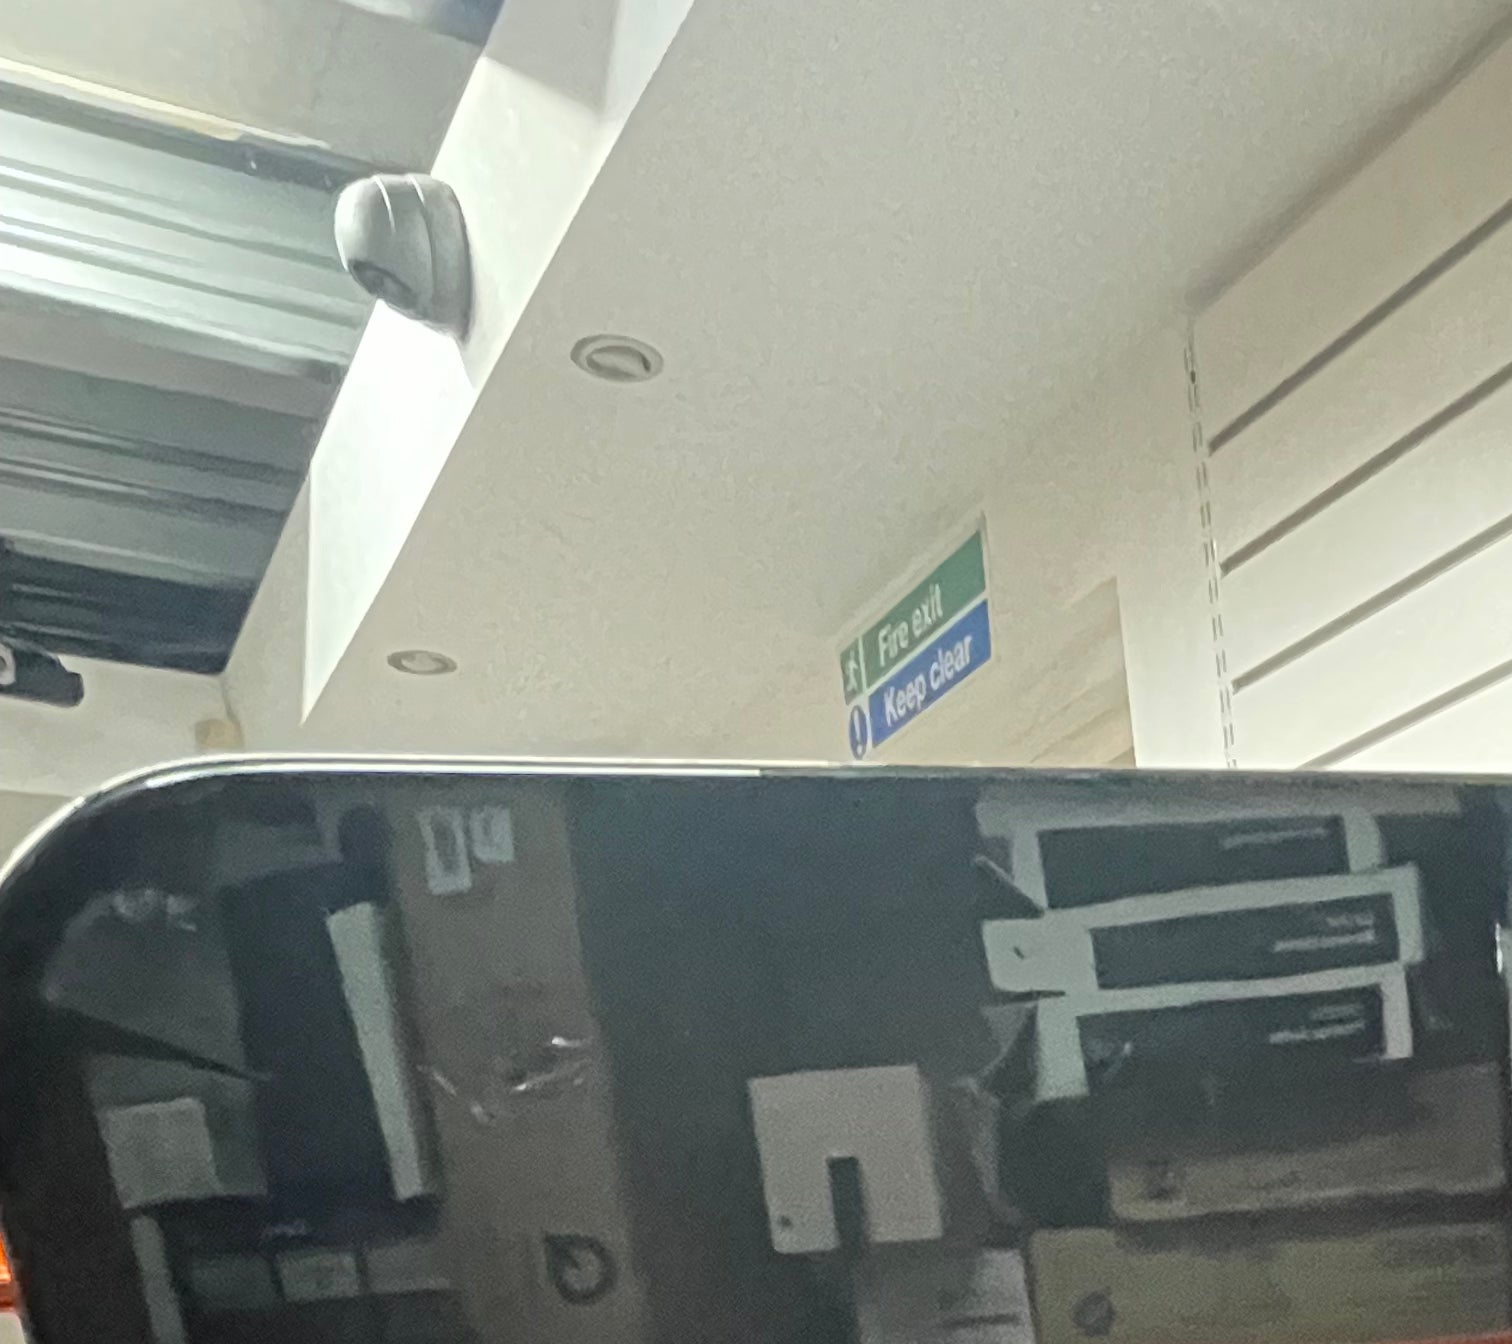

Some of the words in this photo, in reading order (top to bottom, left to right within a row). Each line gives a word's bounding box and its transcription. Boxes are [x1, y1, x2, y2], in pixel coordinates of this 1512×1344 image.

[878, 623, 909, 668] Fire
[912, 584, 944, 638] exit
[883, 677, 927, 727] Keep
[929, 636, 973, 690] clear
